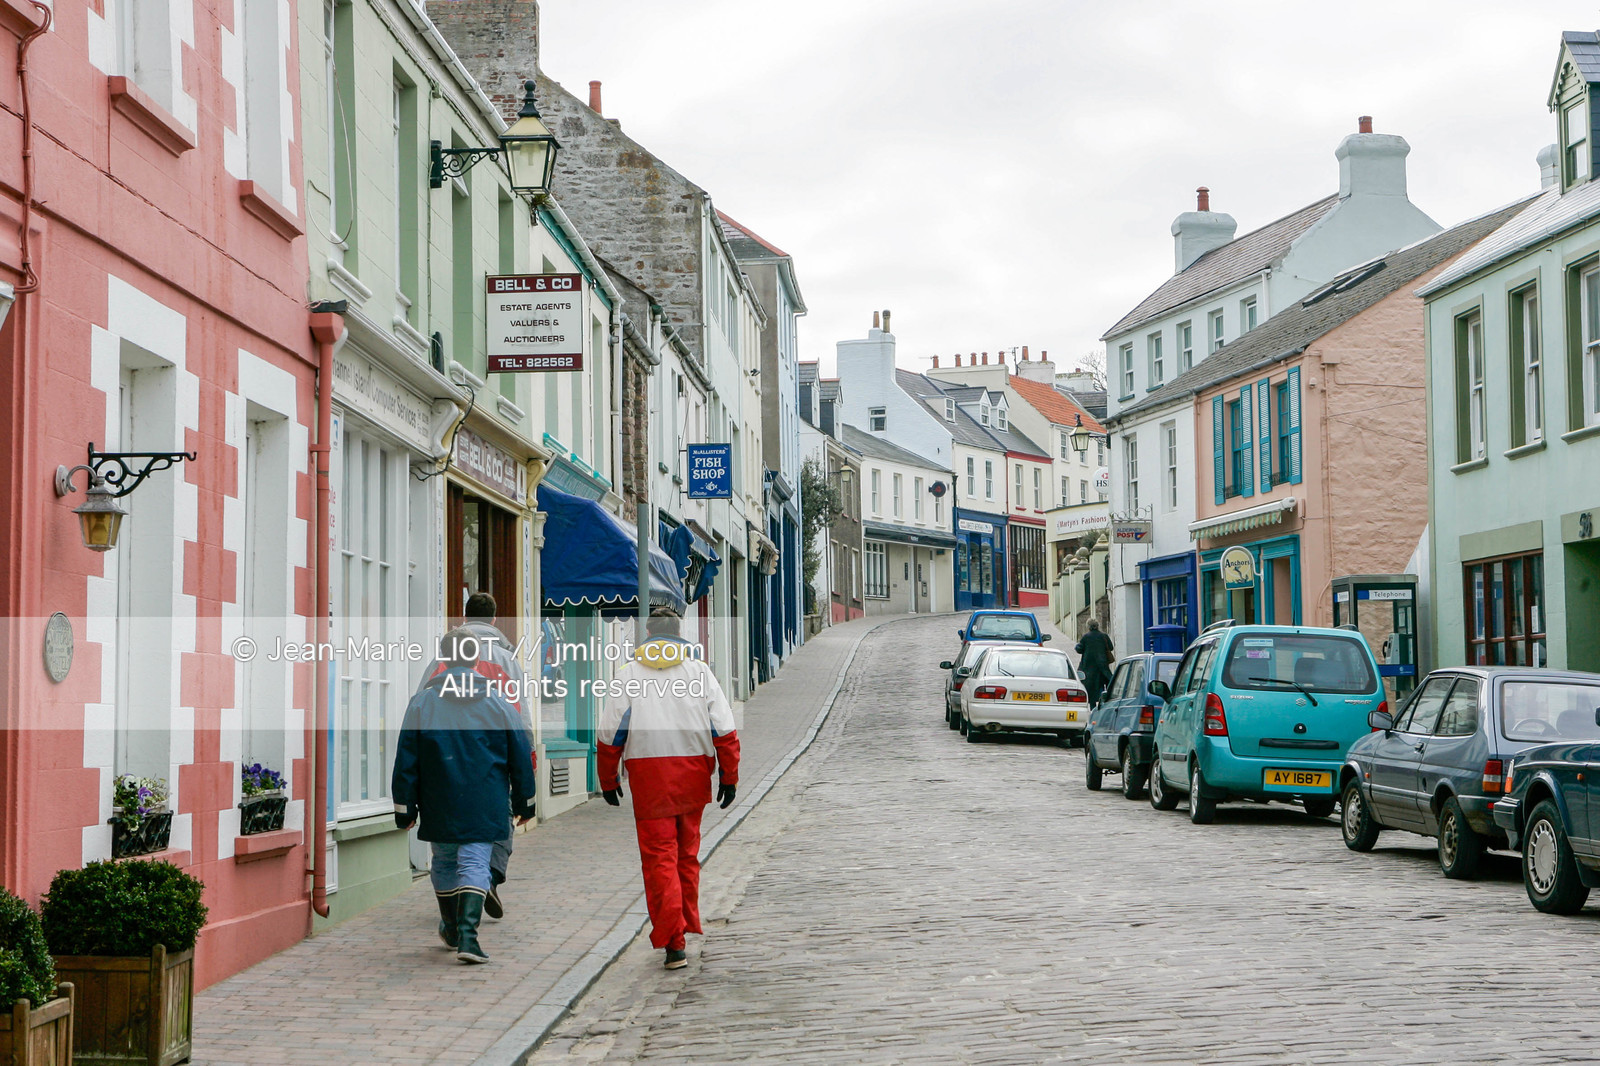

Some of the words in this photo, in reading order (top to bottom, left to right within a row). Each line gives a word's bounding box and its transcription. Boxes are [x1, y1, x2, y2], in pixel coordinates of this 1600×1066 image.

[495, 279, 530, 291] BELL
[536, 278, 546, 290] &
[551, 277, 572, 290] CO
[510, 319, 550, 327] VALUERS
[504, 335, 565, 343] AUCTIONEERS
[498, 358, 522, 368] TEL:
[526, 357, 573, 367] 822562
[470, 442, 485, 474] BELL
[487, 454, 492, 478] &
[492, 457, 503, 484] CO
[694, 457, 722, 468] FISH
[692, 468, 725, 480] SHOP
[1081, 515, 1107, 525] Fashions
[1225, 559, 1251, 568] Anchors
[1374, 591, 1406, 599] Telephone
[1017, 692, 1027, 700] AY
[1274, 772, 1290, 783] AY
[1293, 772, 1322, 784] 1687
